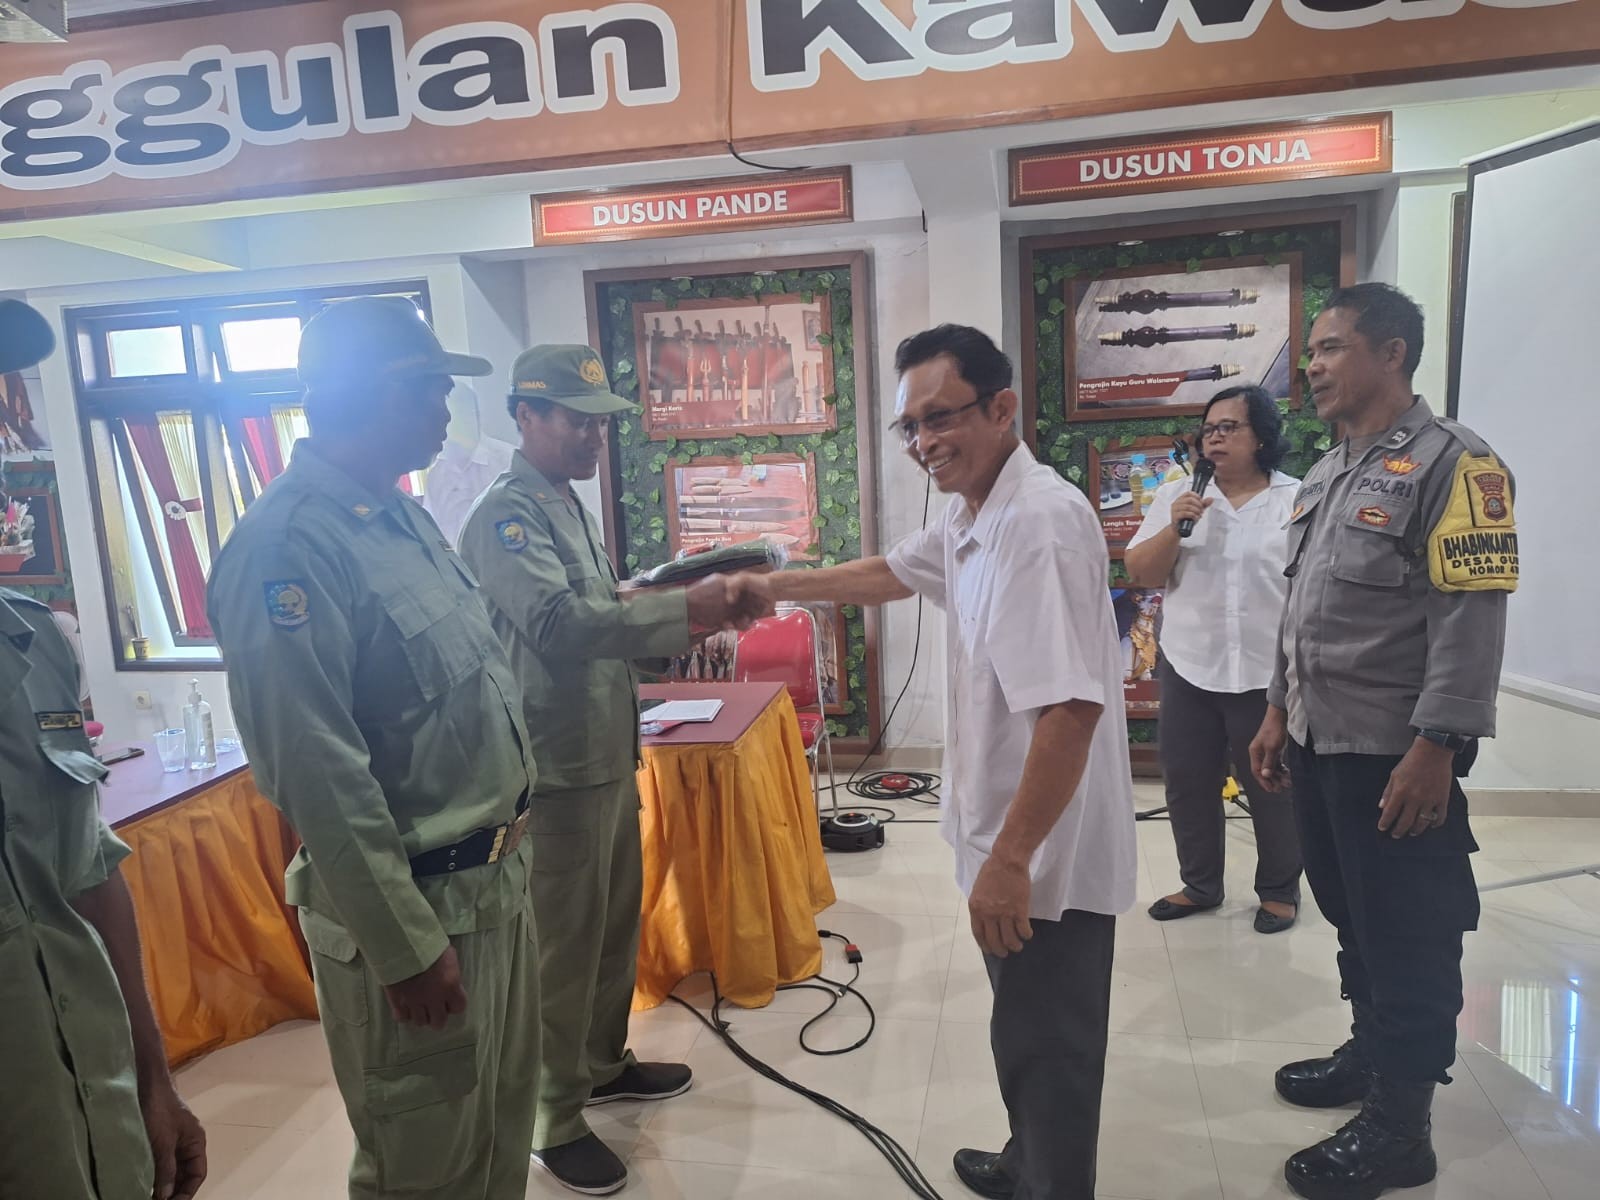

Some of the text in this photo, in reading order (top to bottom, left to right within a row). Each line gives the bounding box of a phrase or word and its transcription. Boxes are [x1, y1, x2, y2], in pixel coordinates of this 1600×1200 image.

[1079, 139, 1311, 183] DUSUN TONJA
[592, 190, 788, 226] DUSUN PANDE
[1358, 477, 1413, 498] POLRI
[1452, 556, 1493, 569] DESA
[1468, 565, 1504, 576] NOMOR
